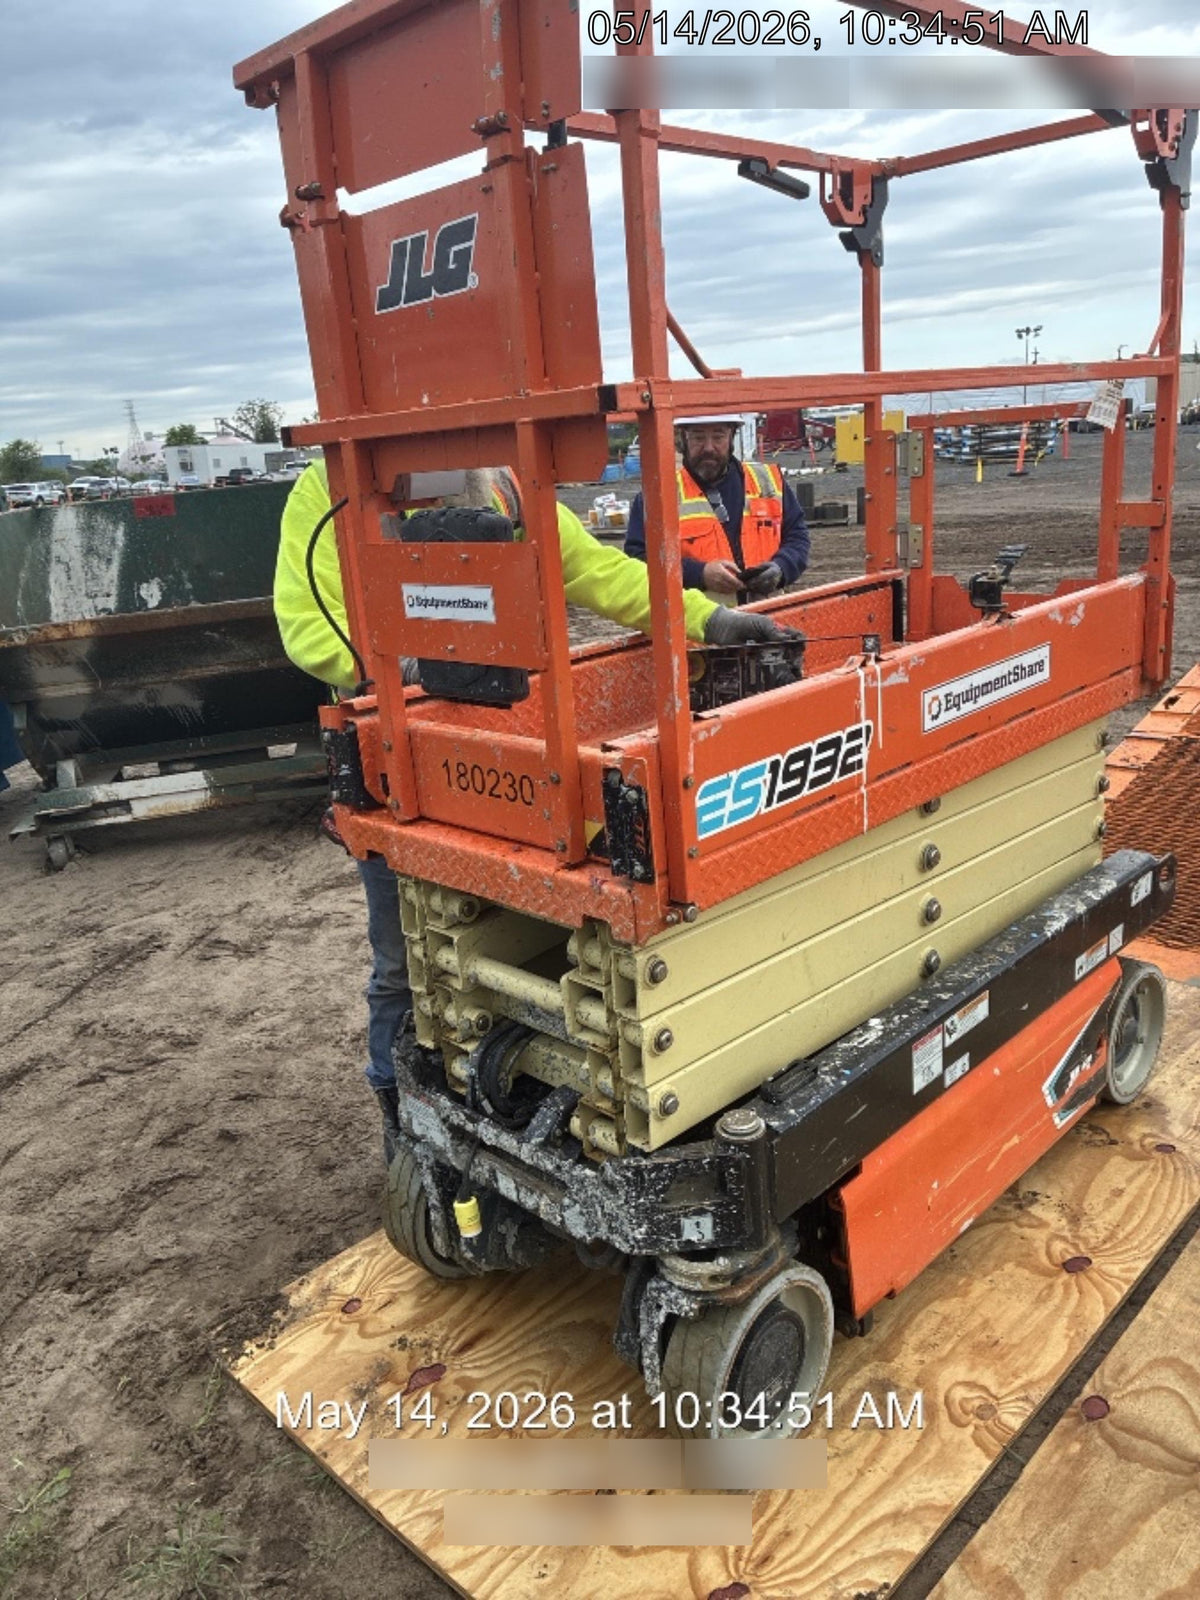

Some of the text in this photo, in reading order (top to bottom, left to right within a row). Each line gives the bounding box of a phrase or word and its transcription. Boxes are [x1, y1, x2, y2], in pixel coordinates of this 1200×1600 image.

[375, 213, 478, 314] JLG
[415, 595, 488, 610] EquipmentShare
[943, 657, 1046, 712] EquipmentShare
[442, 758, 535, 806] 180230
[696, 720, 873, 840] ES1932
